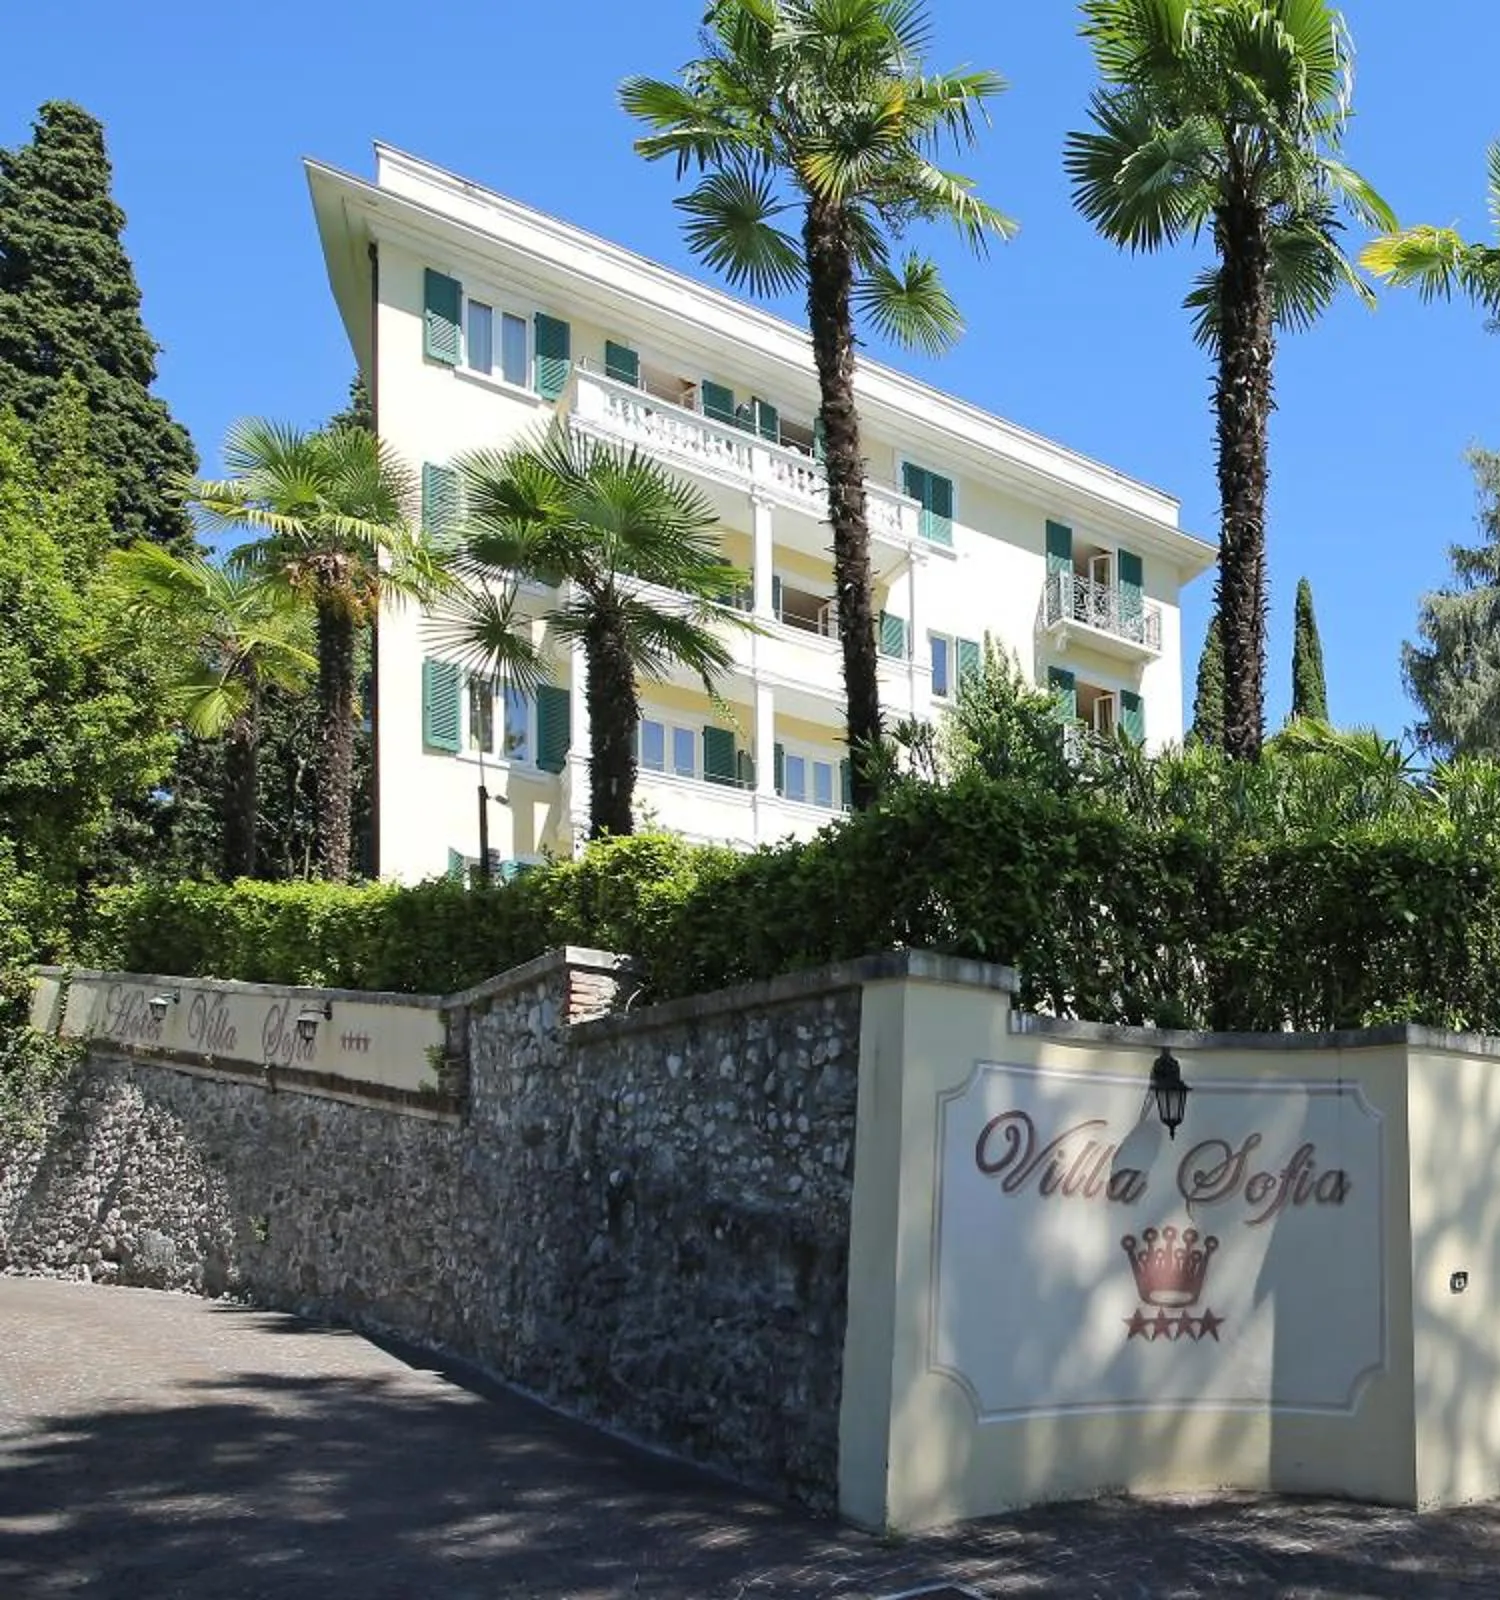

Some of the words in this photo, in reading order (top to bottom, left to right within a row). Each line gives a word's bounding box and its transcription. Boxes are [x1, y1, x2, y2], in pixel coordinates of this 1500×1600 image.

[188, 993, 237, 1051] Villa
[976, 1109, 1148, 1205] Villa
[1177, 1132, 1351, 1227] Sofia
